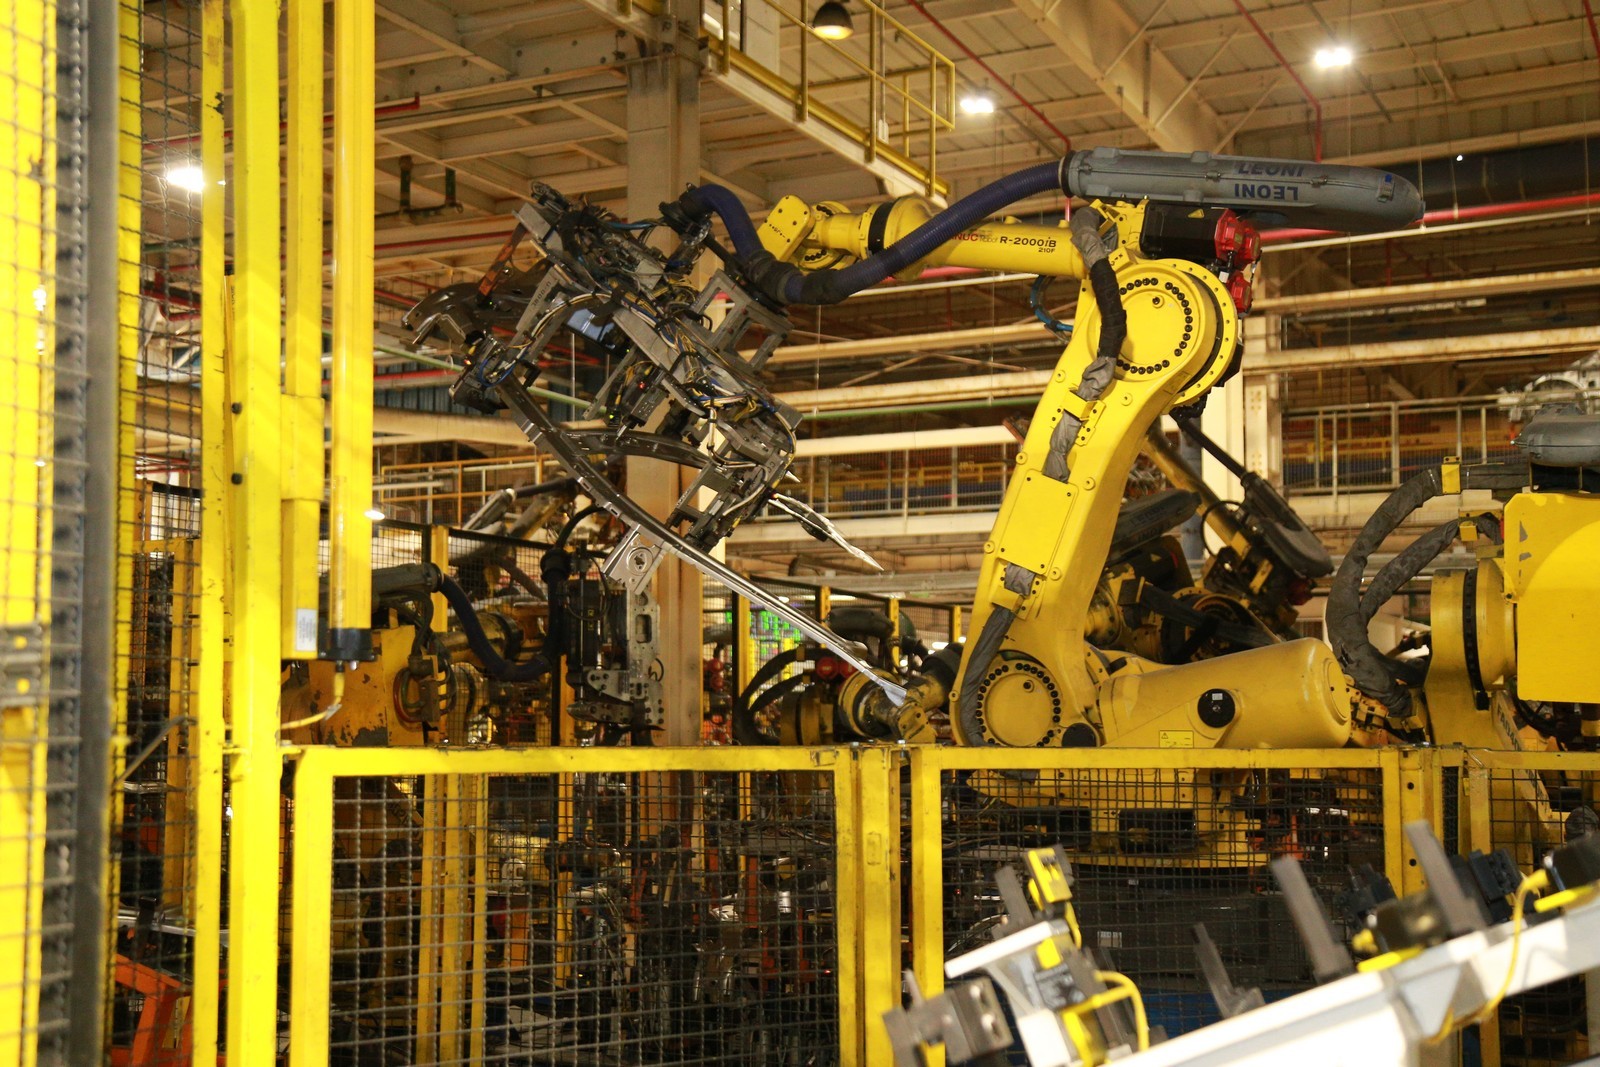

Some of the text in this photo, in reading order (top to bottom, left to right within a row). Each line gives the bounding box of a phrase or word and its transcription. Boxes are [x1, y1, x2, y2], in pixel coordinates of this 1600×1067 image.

[1238, 161, 1304, 177] LEONI
[1234, 183, 1299, 201] LEONI
[951, 233, 979, 242] NUC
[999, 236, 1057, 248] R-2000iB
